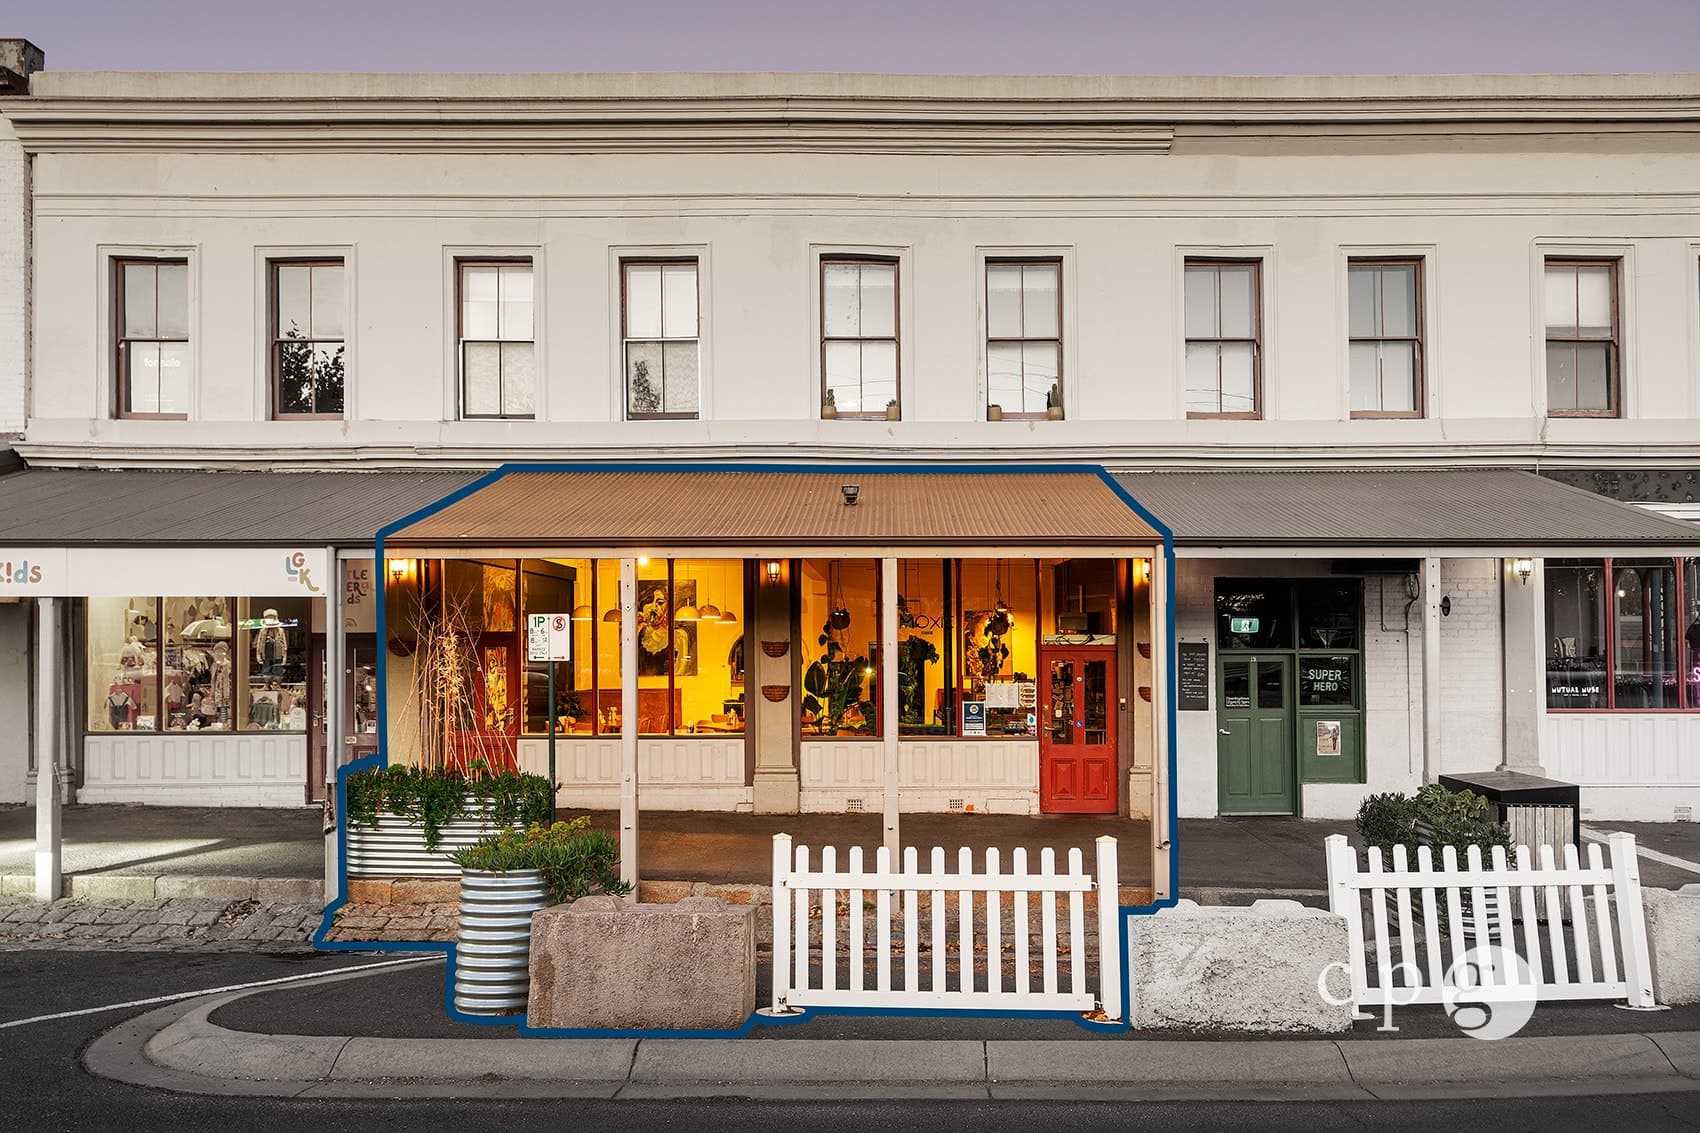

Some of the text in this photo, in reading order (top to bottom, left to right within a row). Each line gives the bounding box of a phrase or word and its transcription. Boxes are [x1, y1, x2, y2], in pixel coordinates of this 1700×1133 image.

[534, 616, 546, 628] 1P
[1309, 669, 1342, 681] SUPER
[1313, 681, 1338, 692] HERO
